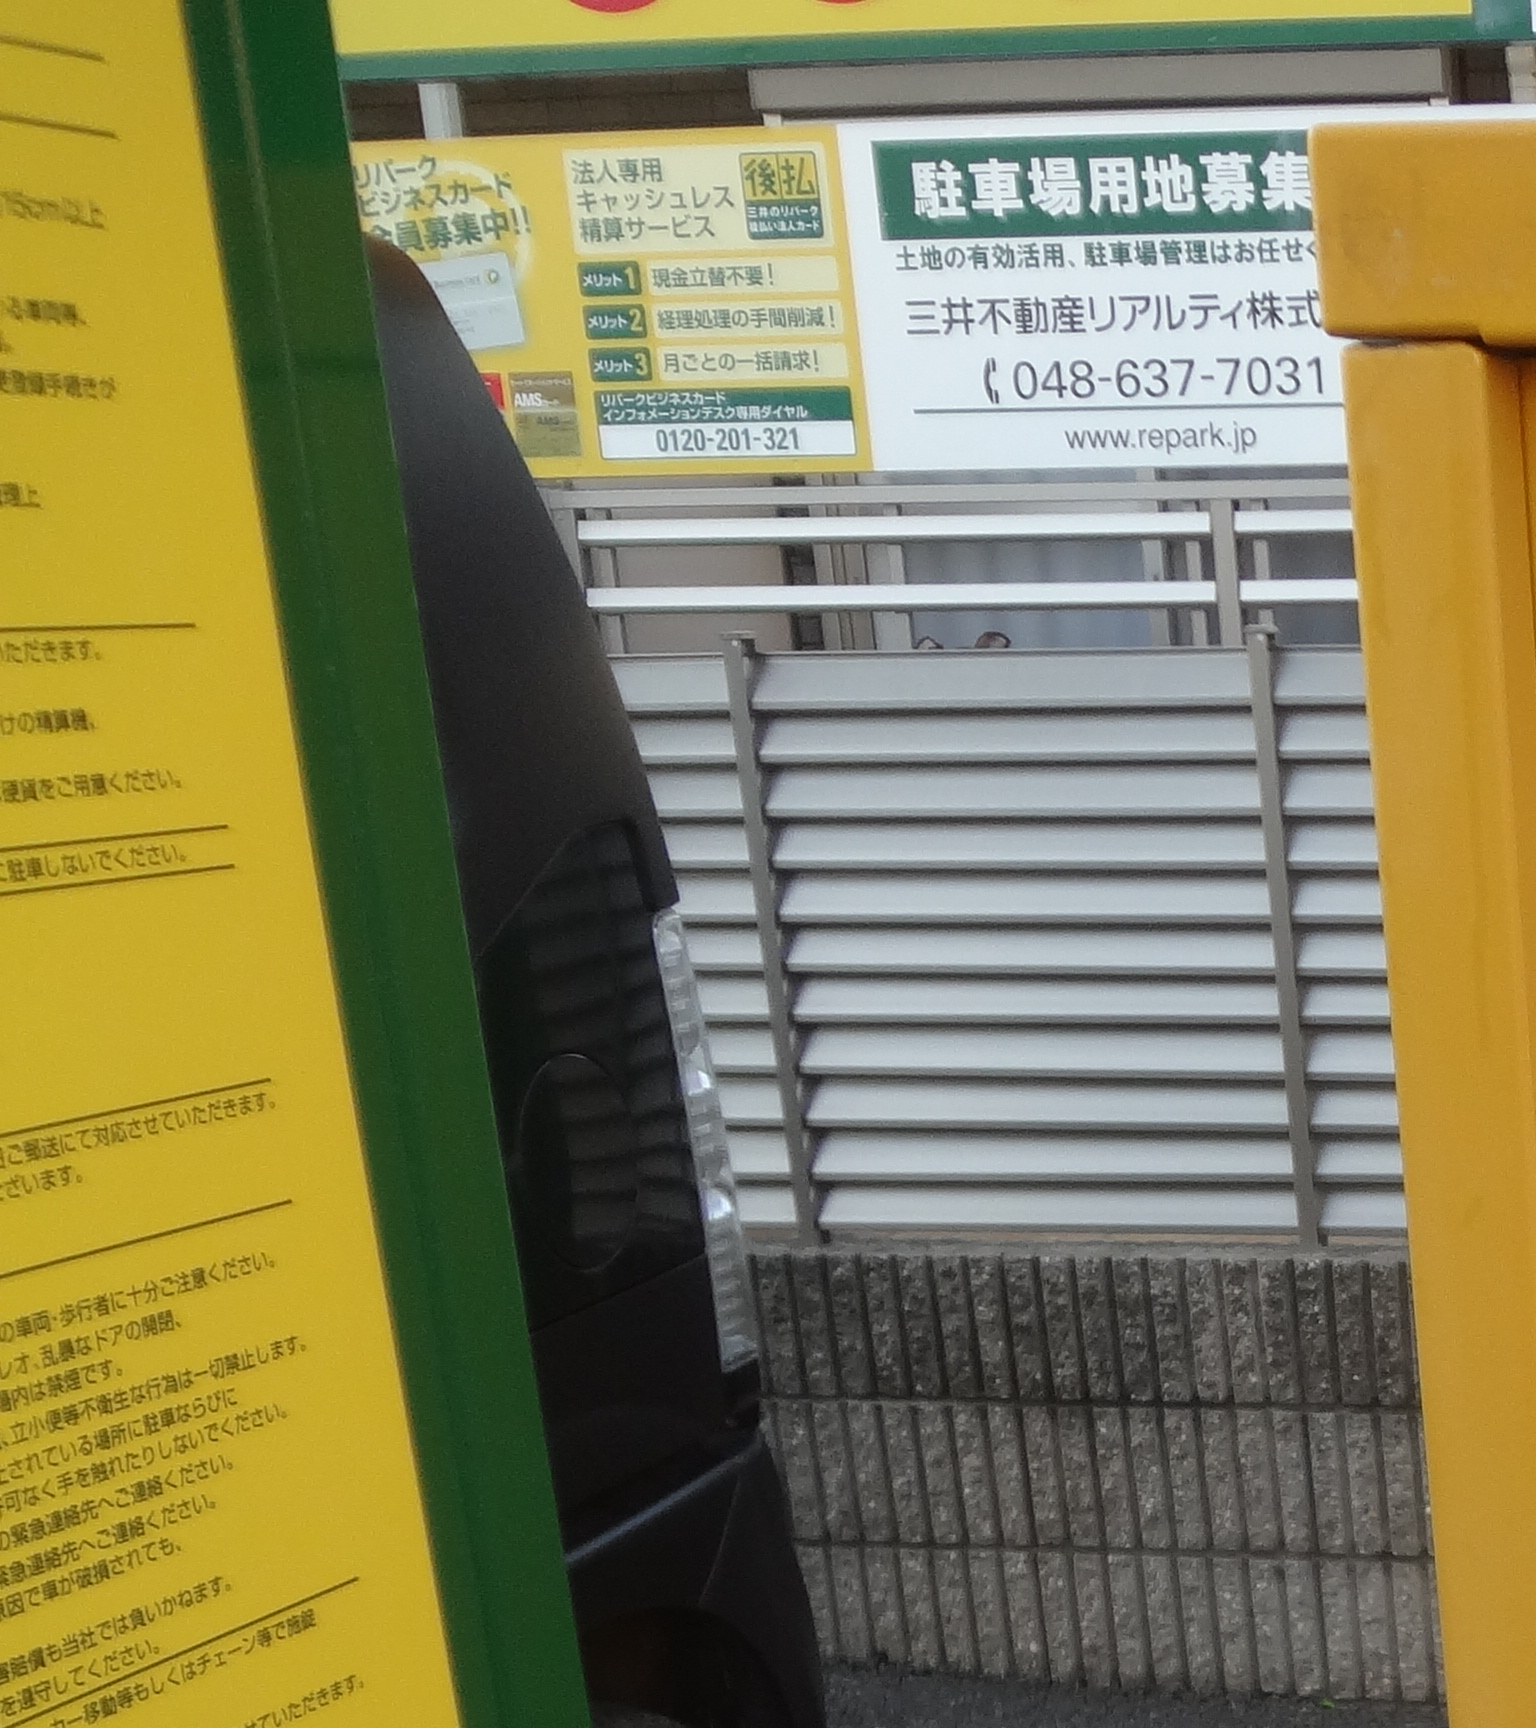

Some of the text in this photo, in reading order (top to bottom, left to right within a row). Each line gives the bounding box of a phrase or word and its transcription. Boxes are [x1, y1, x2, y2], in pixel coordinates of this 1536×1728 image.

[354, 155, 436, 187] リパーク
[572, 158, 664, 184] 法人専用
[745, 157, 816, 198] 後払
[359, 172, 512, 218] ビジネスカード
[577, 186, 735, 213] キャッシュレス
[910, 152, 1312, 220] 駐車場用地募集
[580, 216, 715, 243] 精算サービス
[652, 262, 774, 288] 現金立替不要!
[658, 306, 836, 332] 経理処理の手間削減!
[905, 290, 1321, 336] 三井不動産リアルティ株式
[664, 351, 820, 374] 月ごとの一括請求!
[1012, 357, 1325, 400] 048-637-7031
[601, 391, 726, 407] リパークビジネスカード
[603, 406, 808, 423] インフォメーションデスク専用ダイヤル
[656, 427, 800, 453] 0120-201-321
[1065, 423, 1257, 454] www.repark.jp
[0, 639, 101, 662] ただきます。
[0, 1403, 287, 1514] 可なく手を触れたりしないでください。
